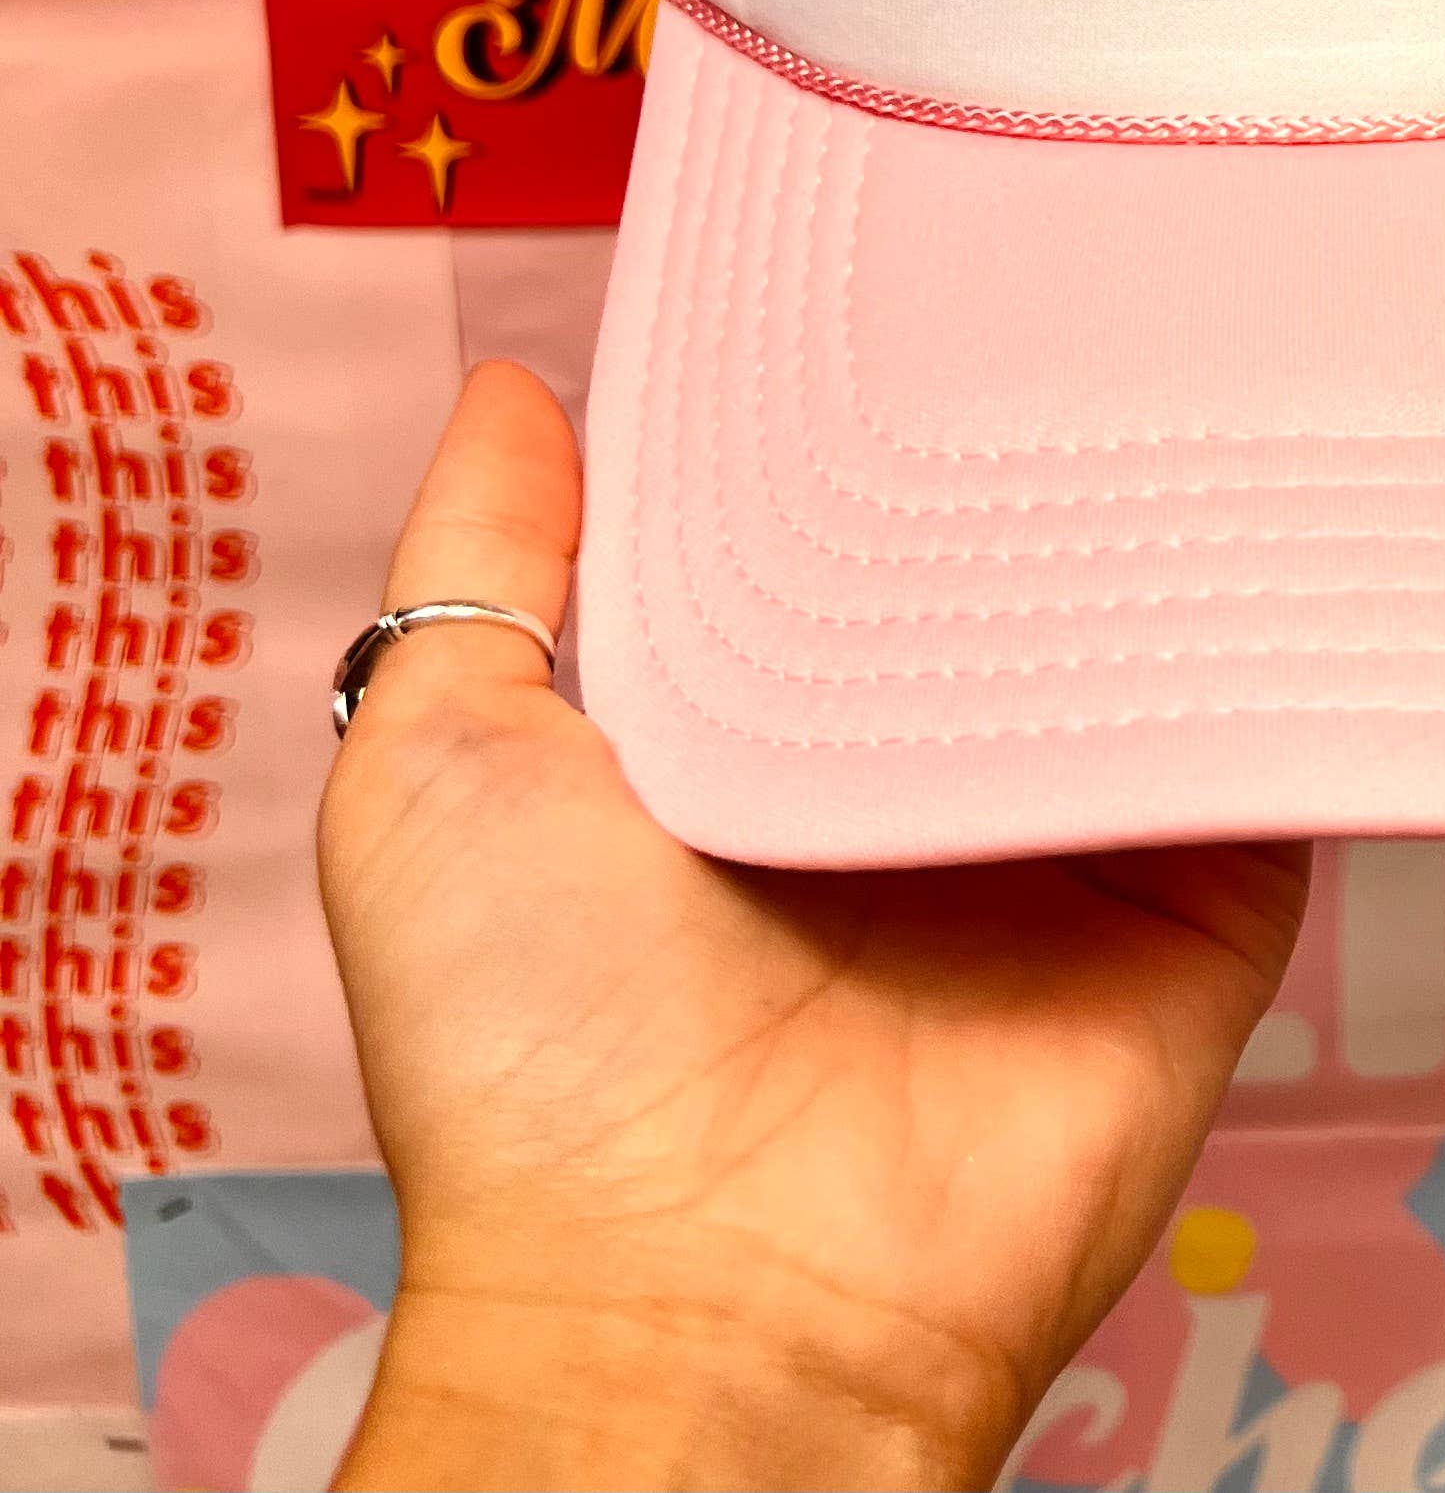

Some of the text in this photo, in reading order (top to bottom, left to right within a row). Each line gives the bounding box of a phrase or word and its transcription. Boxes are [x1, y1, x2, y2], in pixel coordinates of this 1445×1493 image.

[22, 336, 238, 422] this
[44, 421, 254, 504] this
[51, 504, 257, 586] this
[46, 585, 250, 670] this
[30, 674, 236, 756] this
[12, 758, 218, 843] this
[0, 841, 202, 921] this
[0, 918, 196, 998] this
[0, 999, 197, 1076] this
[12, 1077, 216, 1156] this
